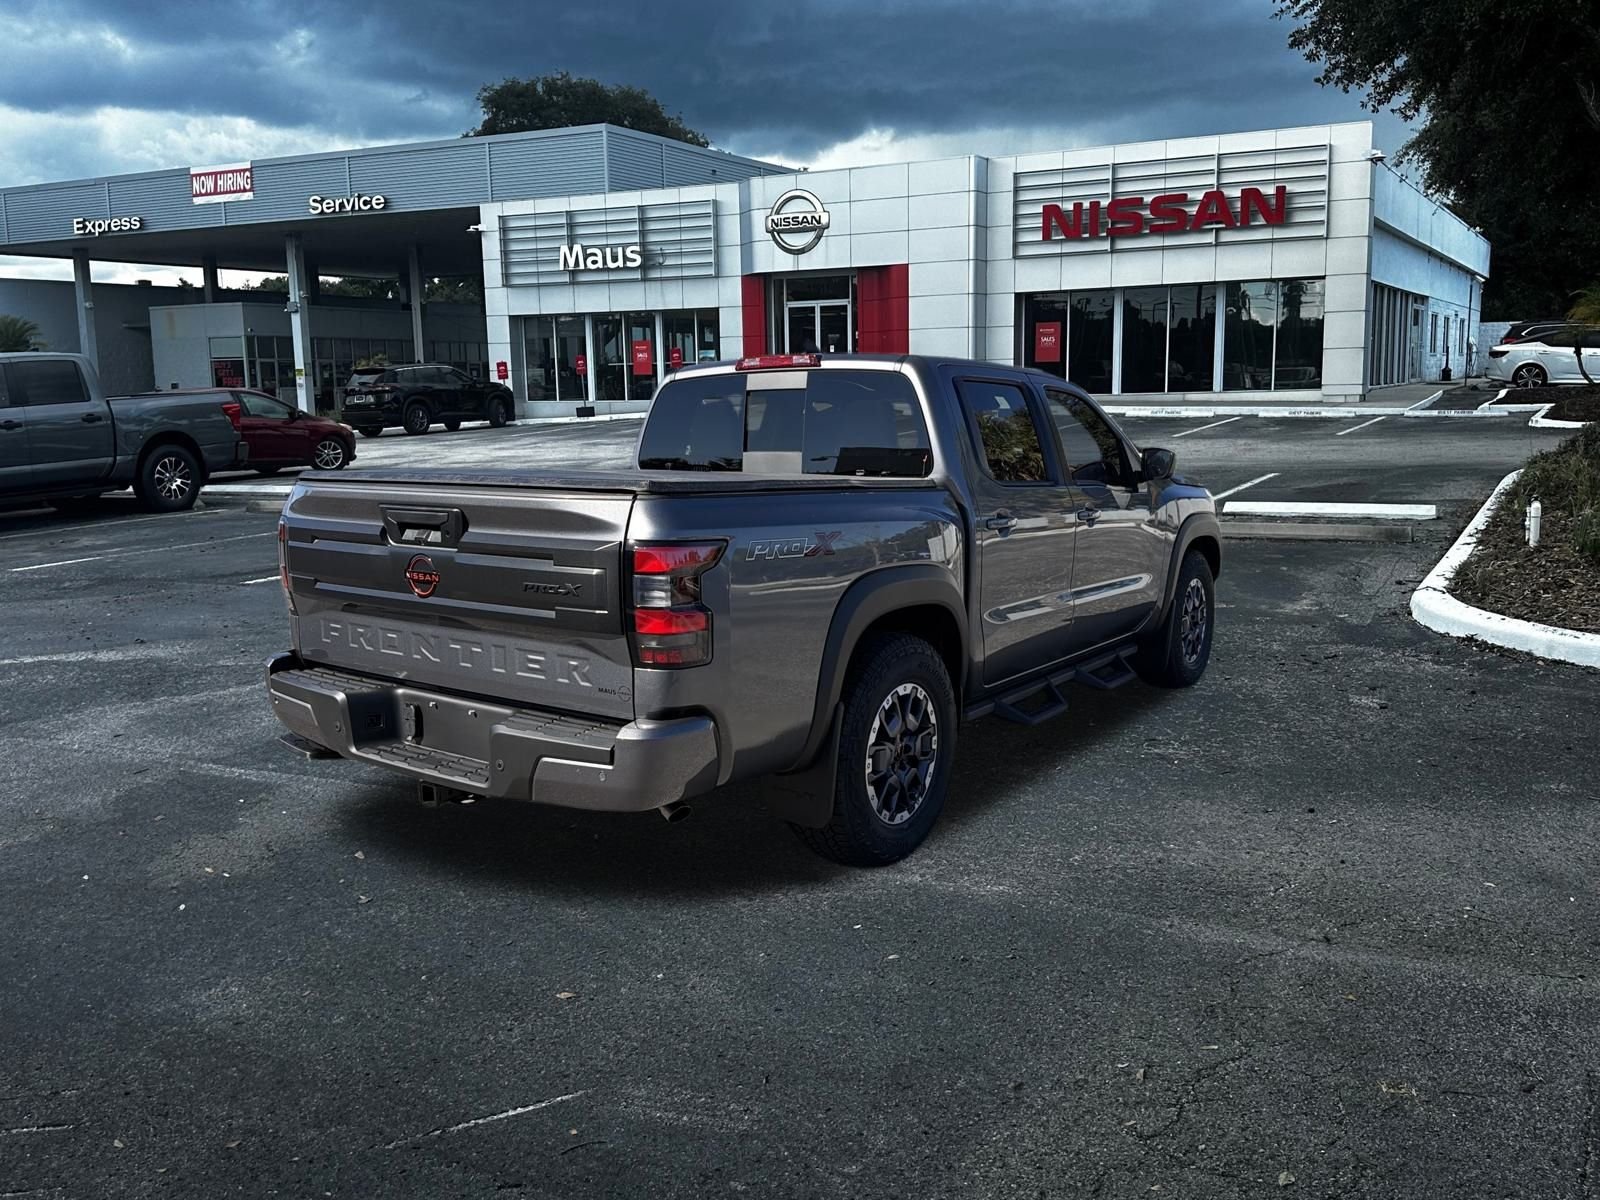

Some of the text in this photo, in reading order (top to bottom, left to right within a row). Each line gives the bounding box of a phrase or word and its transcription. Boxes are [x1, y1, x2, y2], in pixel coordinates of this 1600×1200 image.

[192, 170, 251, 195] NOW HIRING
[308, 192, 385, 215] Service
[1042, 185, 1286, 241] NISSAN
[73, 216, 141, 237] Express
[770, 214, 822, 228] NISSAN
[559, 243, 642, 271] Maus
[319, 617, 593, 688] FRONTIER
[598, 687, 617, 696] MAUS
